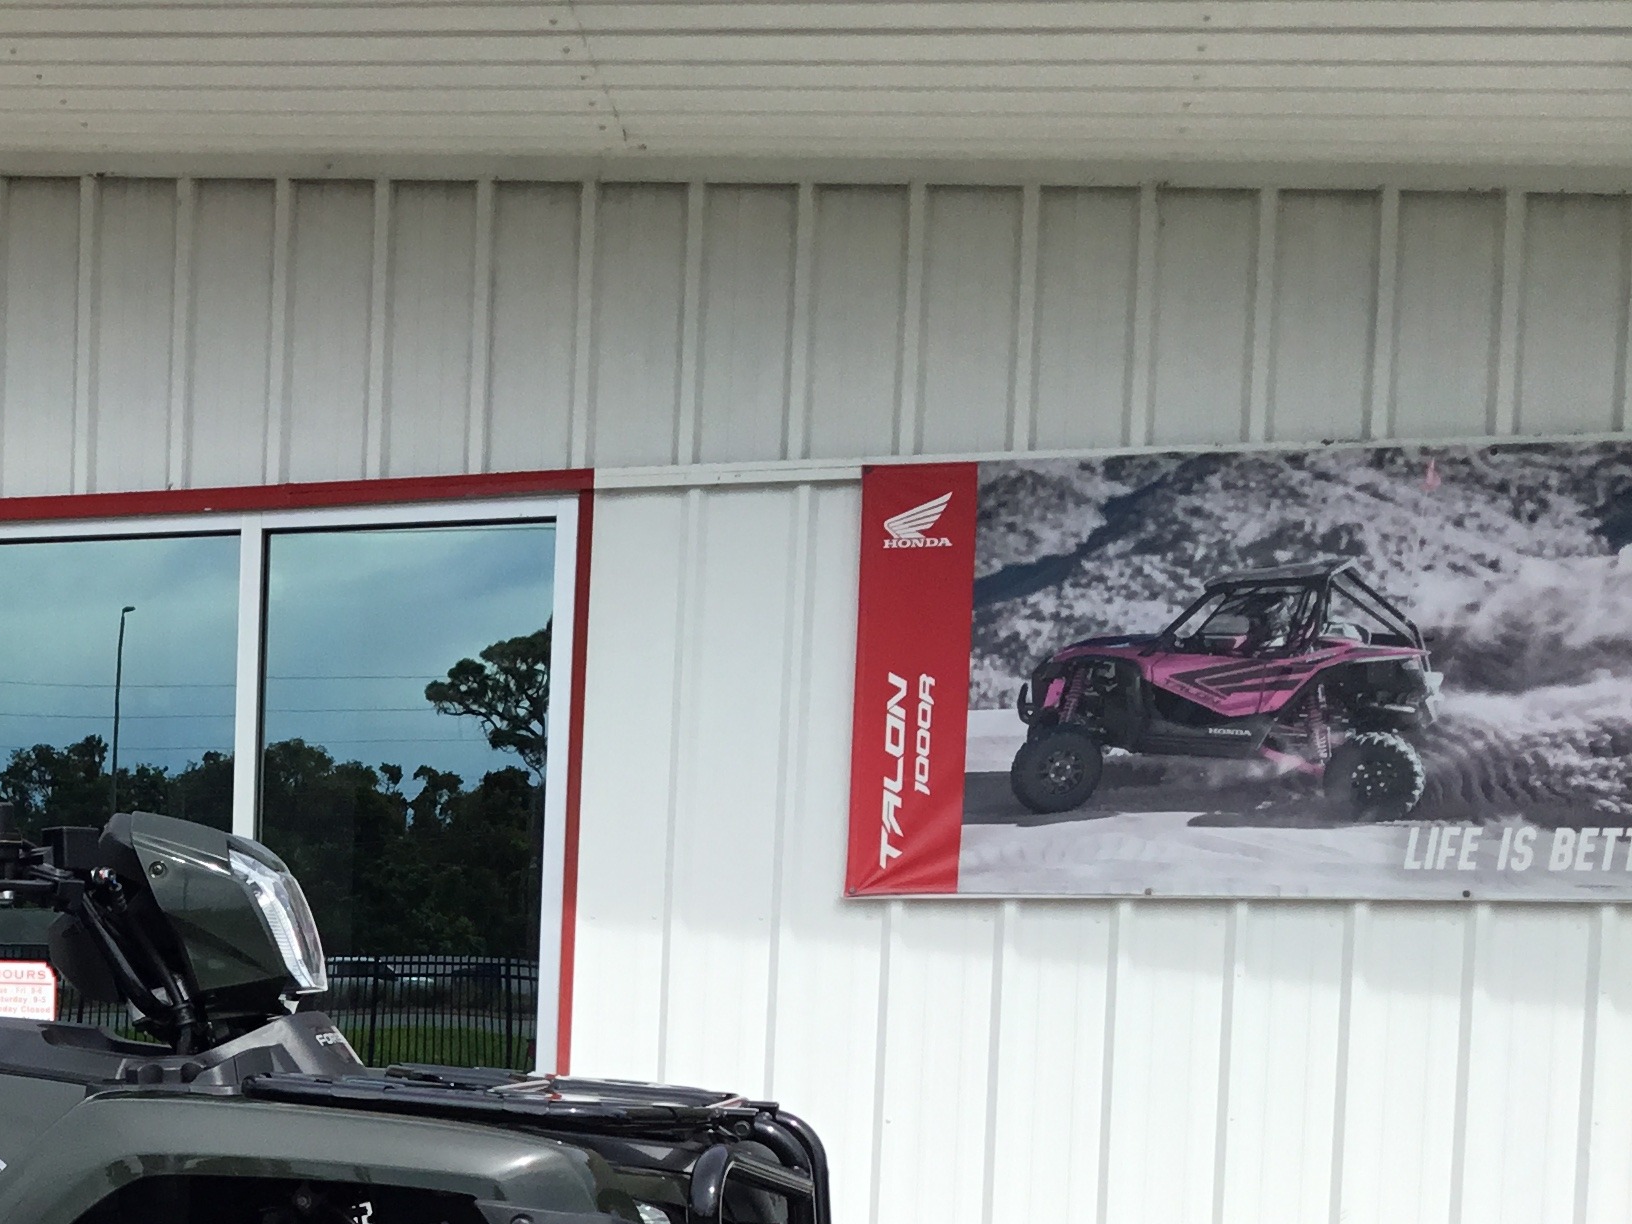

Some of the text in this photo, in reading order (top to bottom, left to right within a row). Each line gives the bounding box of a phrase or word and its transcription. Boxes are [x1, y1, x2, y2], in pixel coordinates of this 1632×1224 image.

[883, 537, 953, 549] HONDA
[914, 673, 936, 796] 1000R
[880, 671, 908, 870] TALON
[1403, 827, 1484, 871] LIFE
[1496, 827, 1538, 872] IS
[21, 1005, 50, 1013] Closed
